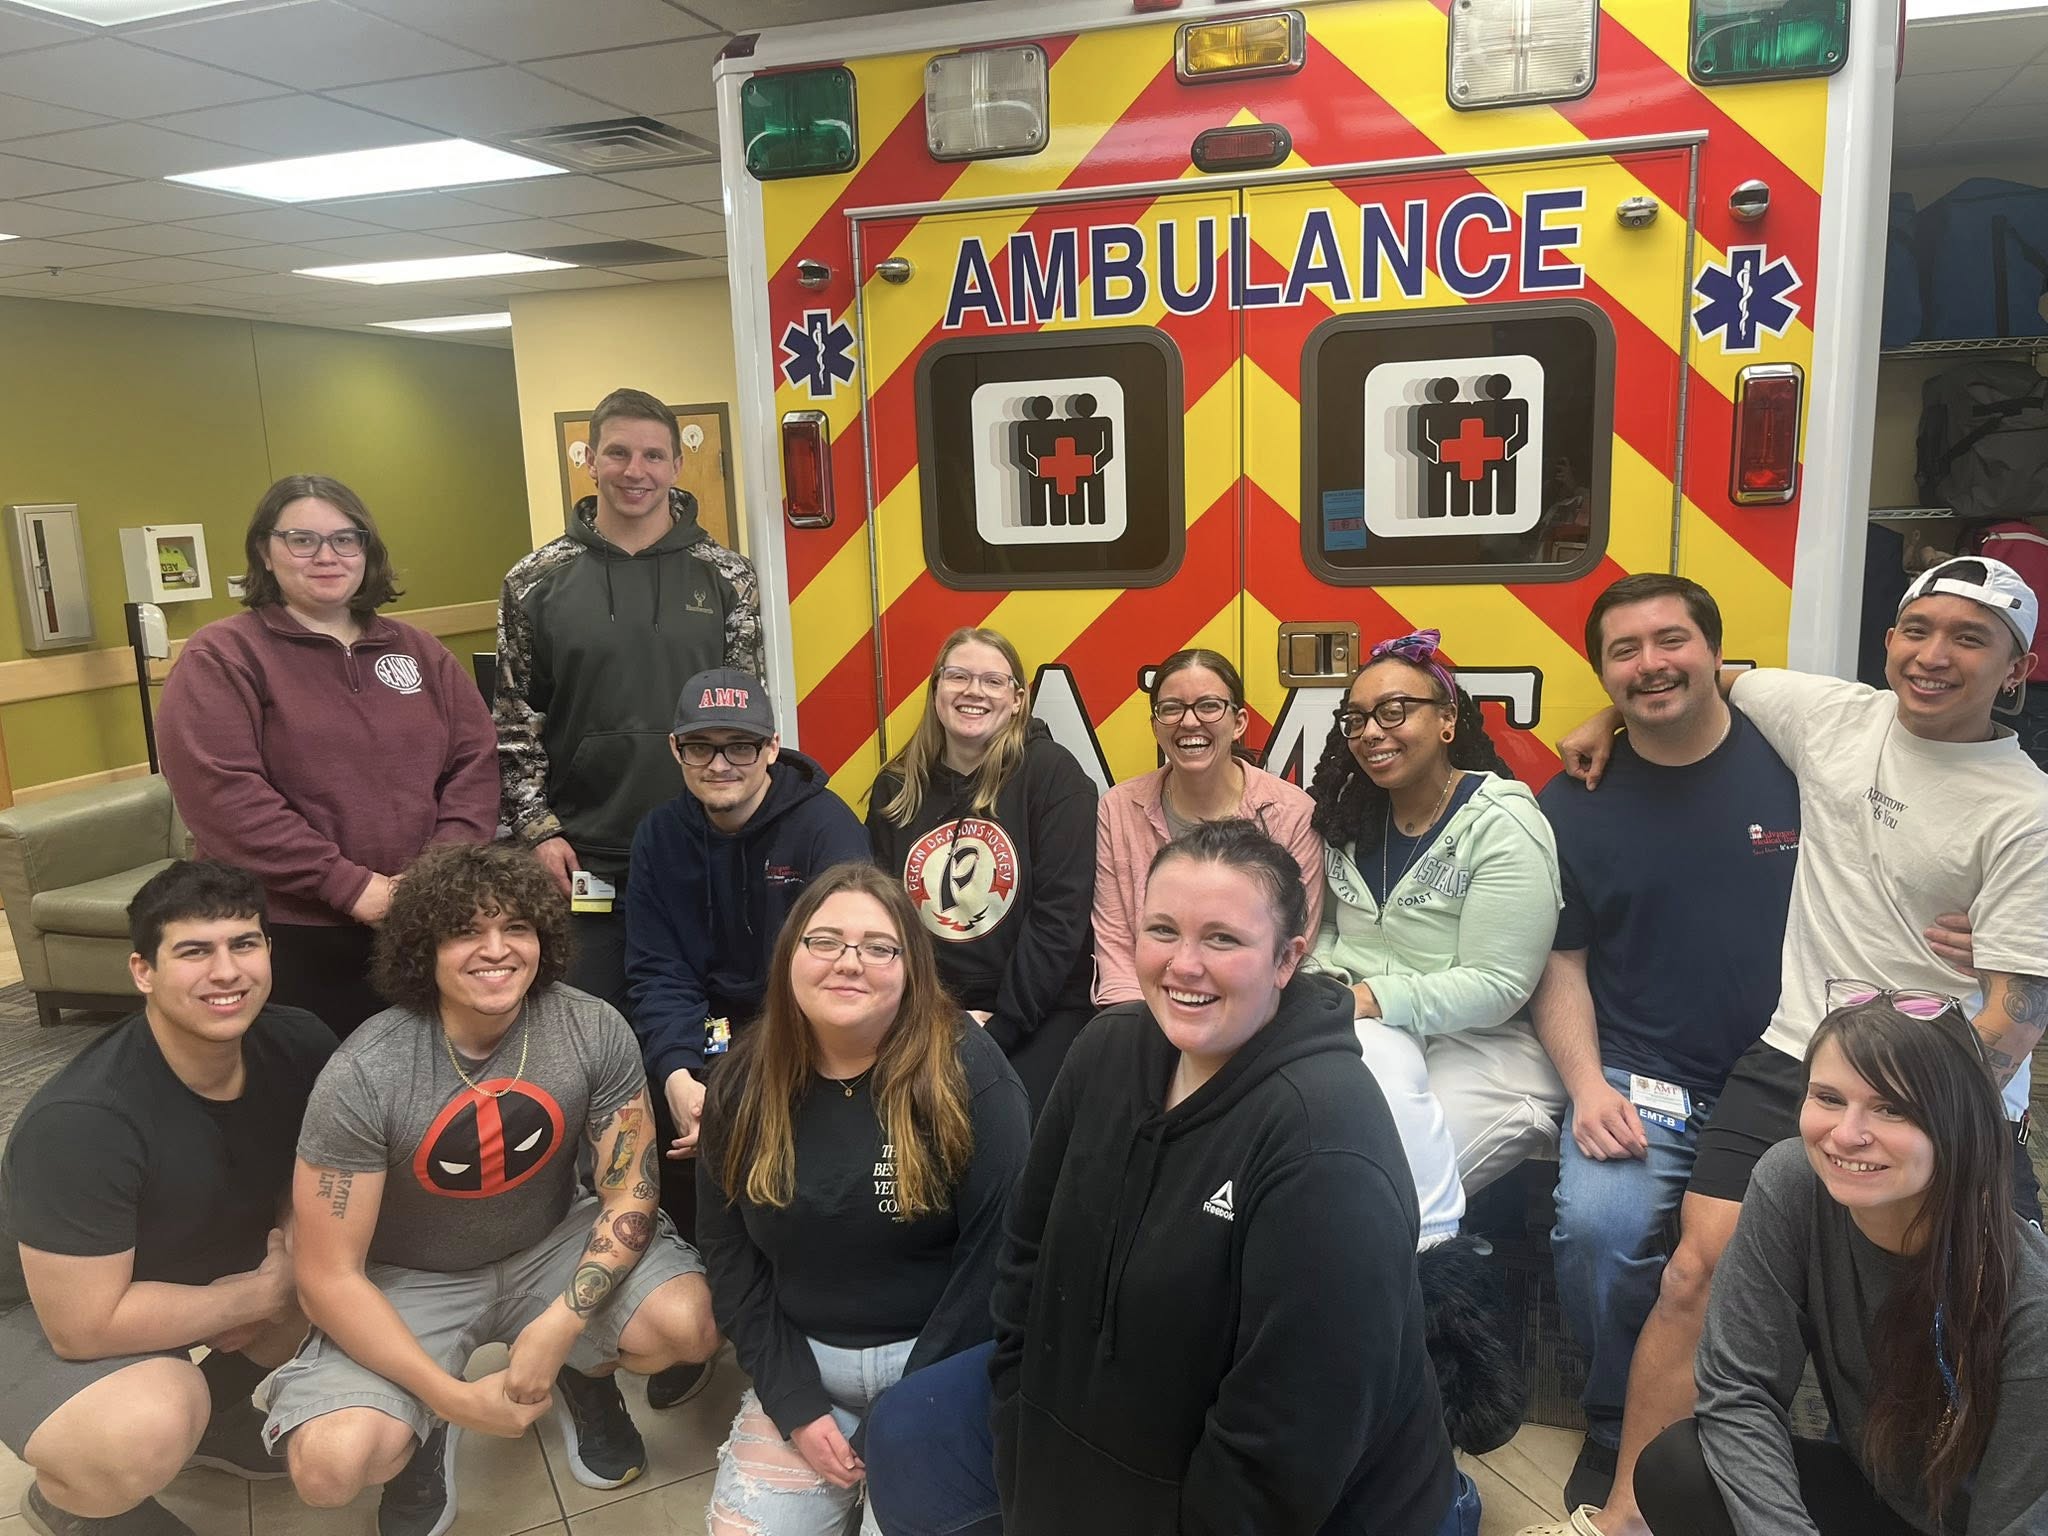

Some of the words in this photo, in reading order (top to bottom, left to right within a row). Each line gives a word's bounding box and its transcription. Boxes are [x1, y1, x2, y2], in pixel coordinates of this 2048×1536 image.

[943, 188, 1587, 329] AMBULANCE
[160, 563, 178, 572] AED
[699, 688, 748, 708] AMT
[908, 849, 927, 891] PEKIN
[927, 823, 986, 849] DRAONS
[985, 829, 1012, 881] HOCKEY
[1338, 886, 1356, 903] EAS
[1397, 892, 1432, 907] COAST
[1639, 1108, 1676, 1127] EMT-B
[881, 1144, 897, 1158] TH
[330, 1169, 354, 1219] REATHE
[1202, 1200, 1236, 1222] Reebok
